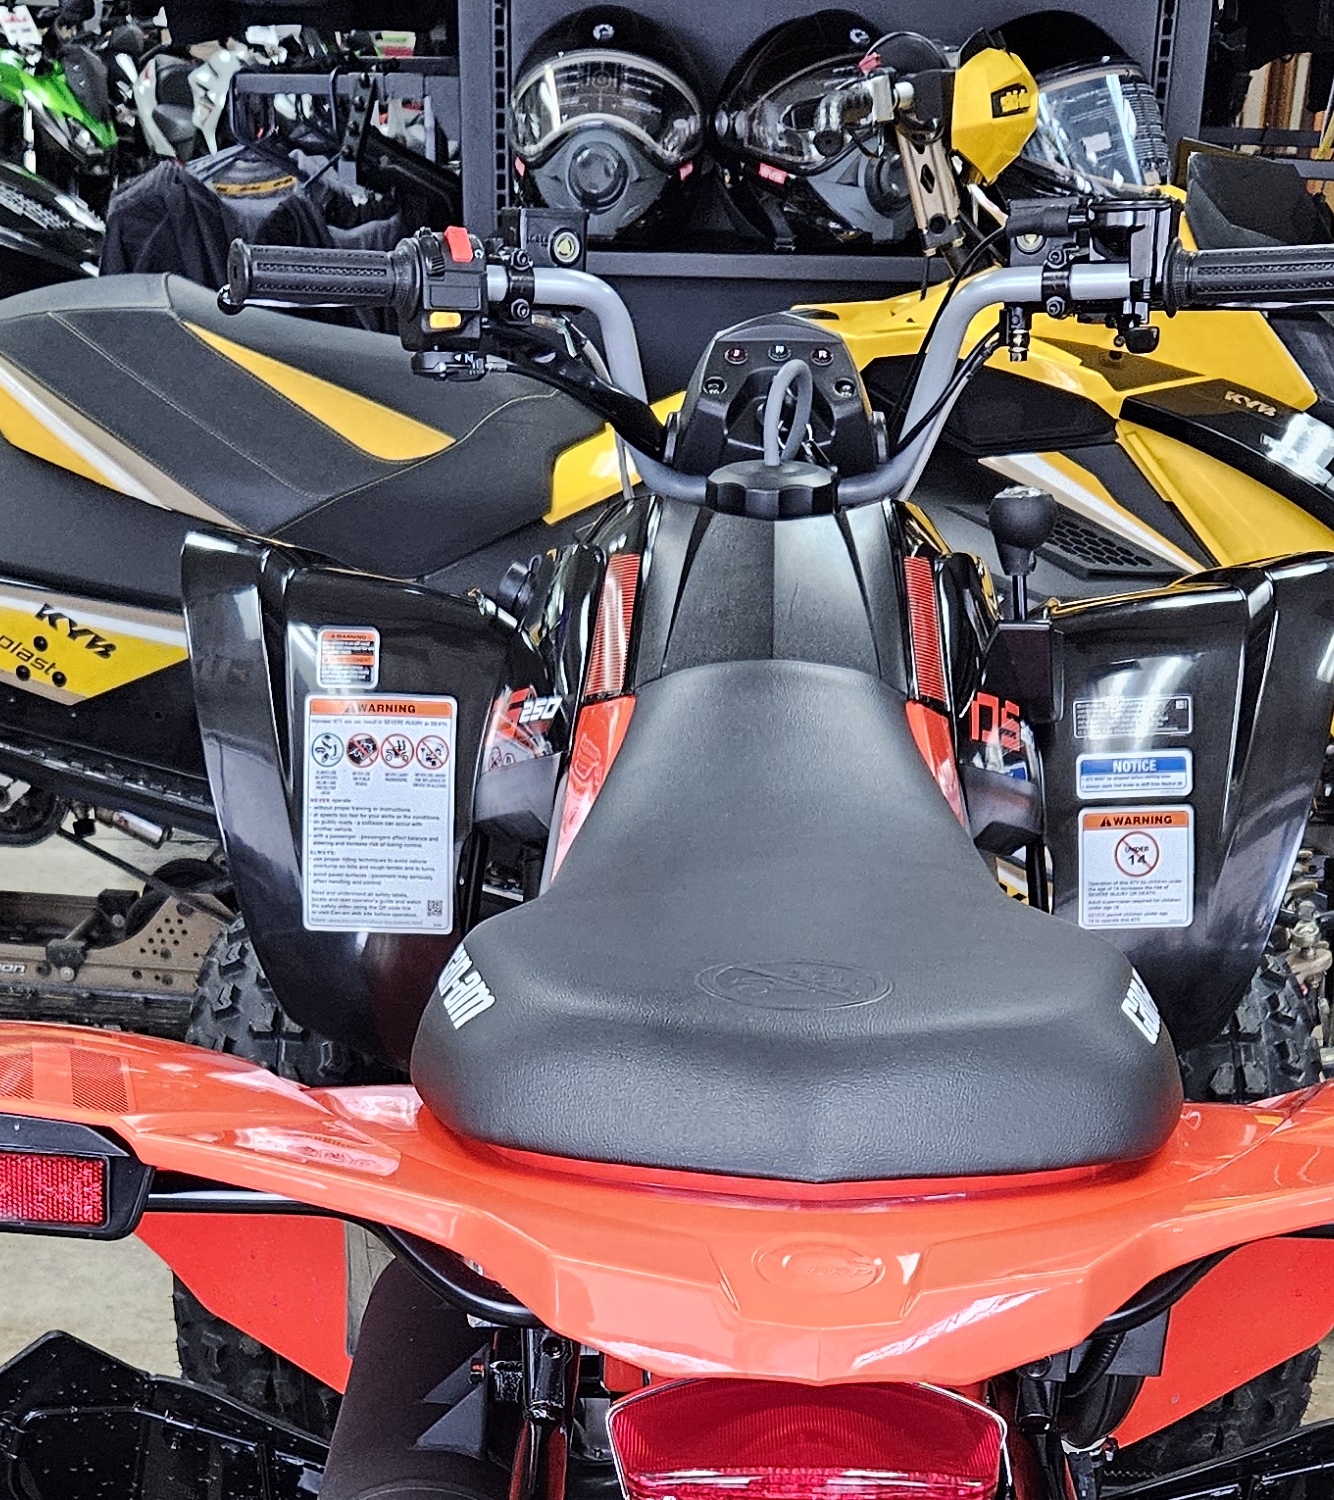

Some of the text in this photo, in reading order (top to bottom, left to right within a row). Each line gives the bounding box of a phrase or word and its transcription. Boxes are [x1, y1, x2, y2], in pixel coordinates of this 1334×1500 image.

[1225, 391, 1277, 417] KYB
[35, 603, 117, 659] KYB
[357, 703, 416, 714] WARNING
[519, 697, 563, 723] 250
[971, 692, 1020, 752] DS
[1113, 759, 1157, 774] NOTICE
[1113, 815, 1173, 826] WARNING
[1128, 854, 1147, 866] 14
